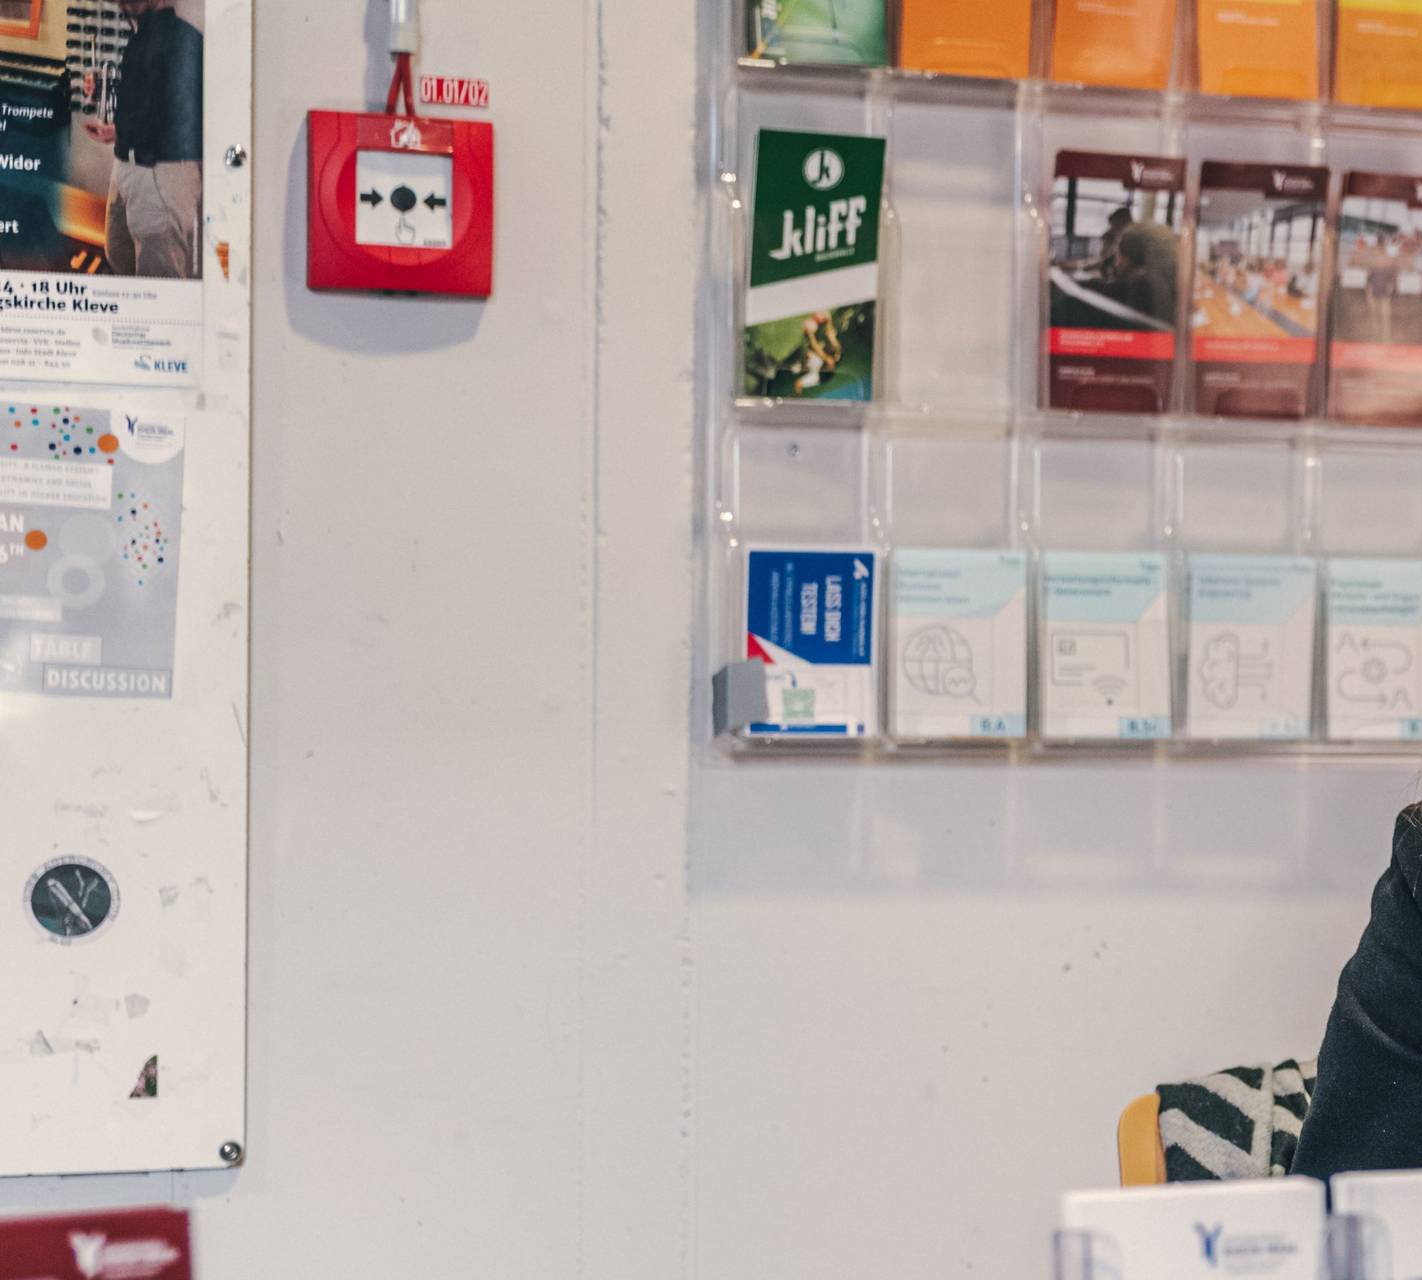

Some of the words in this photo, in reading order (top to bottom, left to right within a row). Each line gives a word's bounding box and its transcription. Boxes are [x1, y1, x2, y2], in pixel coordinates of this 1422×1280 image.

[421, 76, 489, 107] 01.01/02
[1, 103, 54, 120] Trompete
[31, 281, 50, 294] 18
[56, 281, 87, 297] Uhr
[72, 298, 119, 315] Kleve
[154, 359, 189, 374] KLEVE
[47, 668, 167, 693] DISCUSSION
